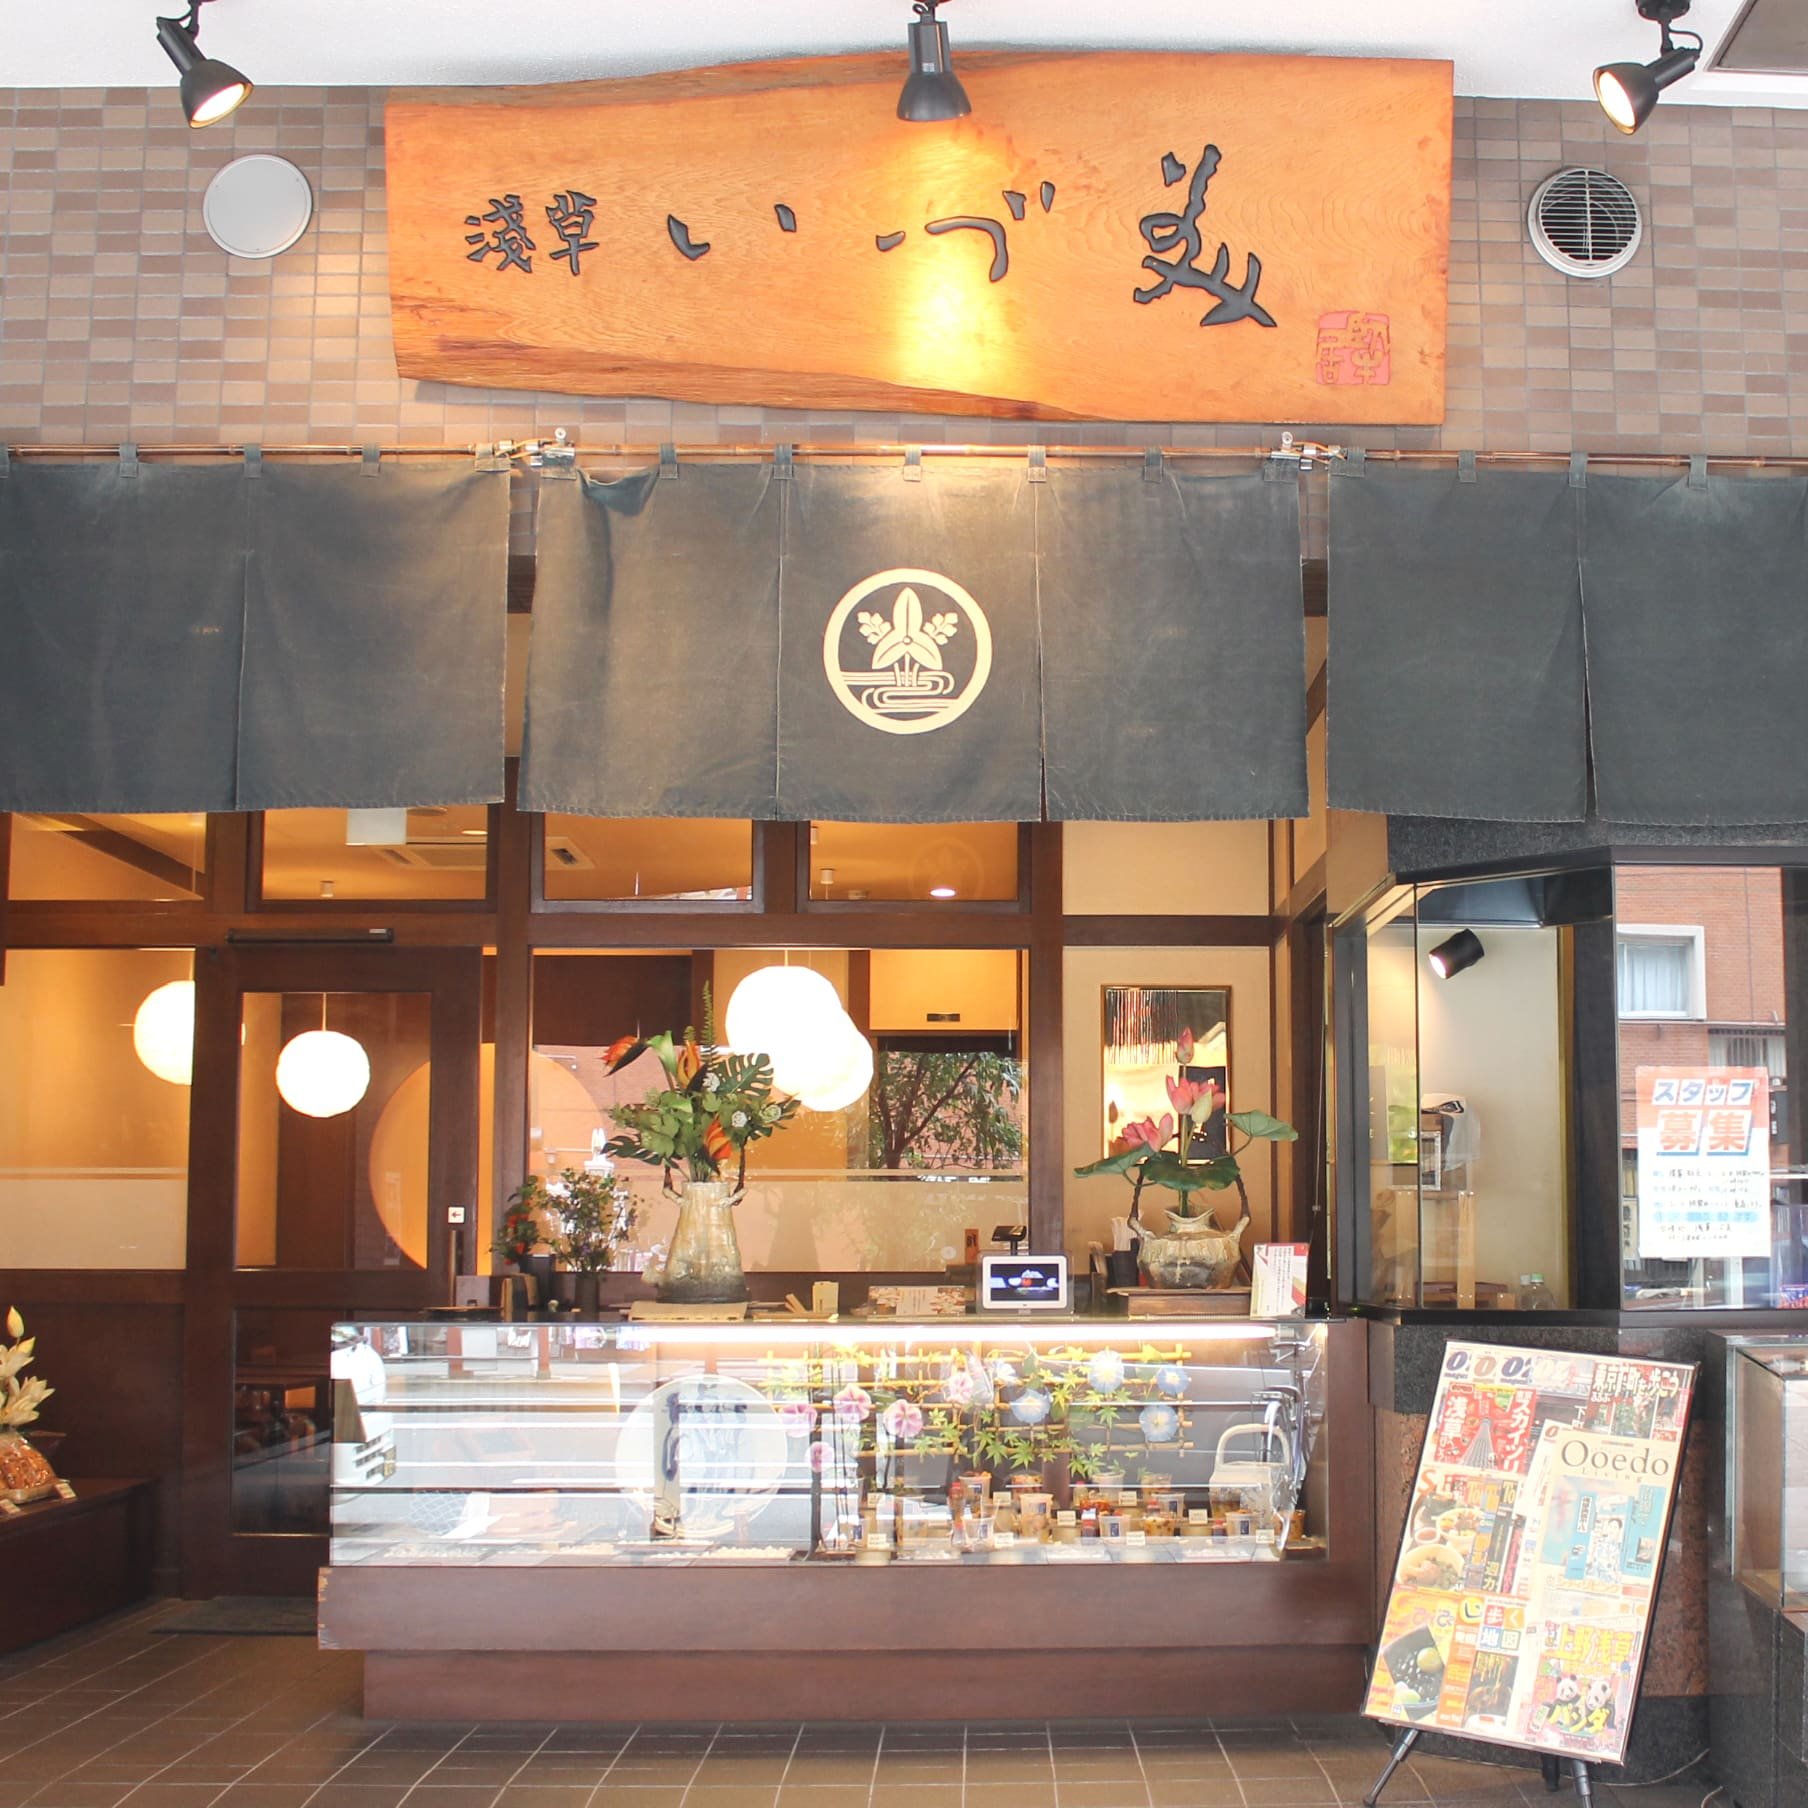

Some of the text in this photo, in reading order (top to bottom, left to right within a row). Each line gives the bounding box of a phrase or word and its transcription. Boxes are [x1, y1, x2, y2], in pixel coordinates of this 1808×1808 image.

[1653, 1080, 1755, 1105] スタッフ
[1658, 1112, 1747, 1151] 募集
[1561, 1440, 1669, 1476] Ooedo
[1547, 1703, 1611, 1734] パンダ
